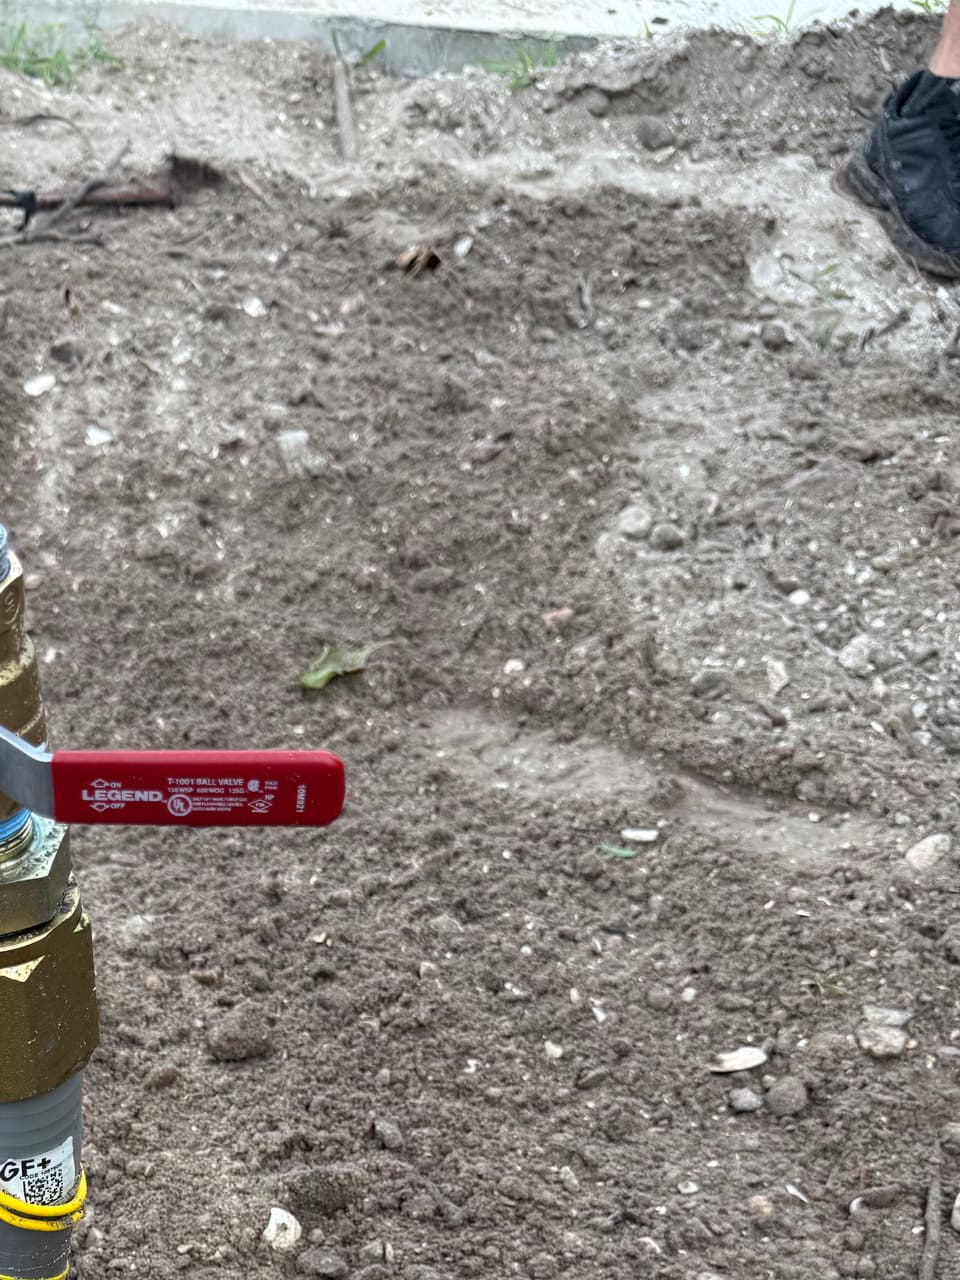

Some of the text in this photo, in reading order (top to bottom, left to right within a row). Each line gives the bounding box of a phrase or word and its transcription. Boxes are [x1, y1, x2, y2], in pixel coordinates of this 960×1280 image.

[196, 778, 216, 786] BALL
[218, 778, 244, 786] VALVE
[81, 790, 163, 802] LEGEND
